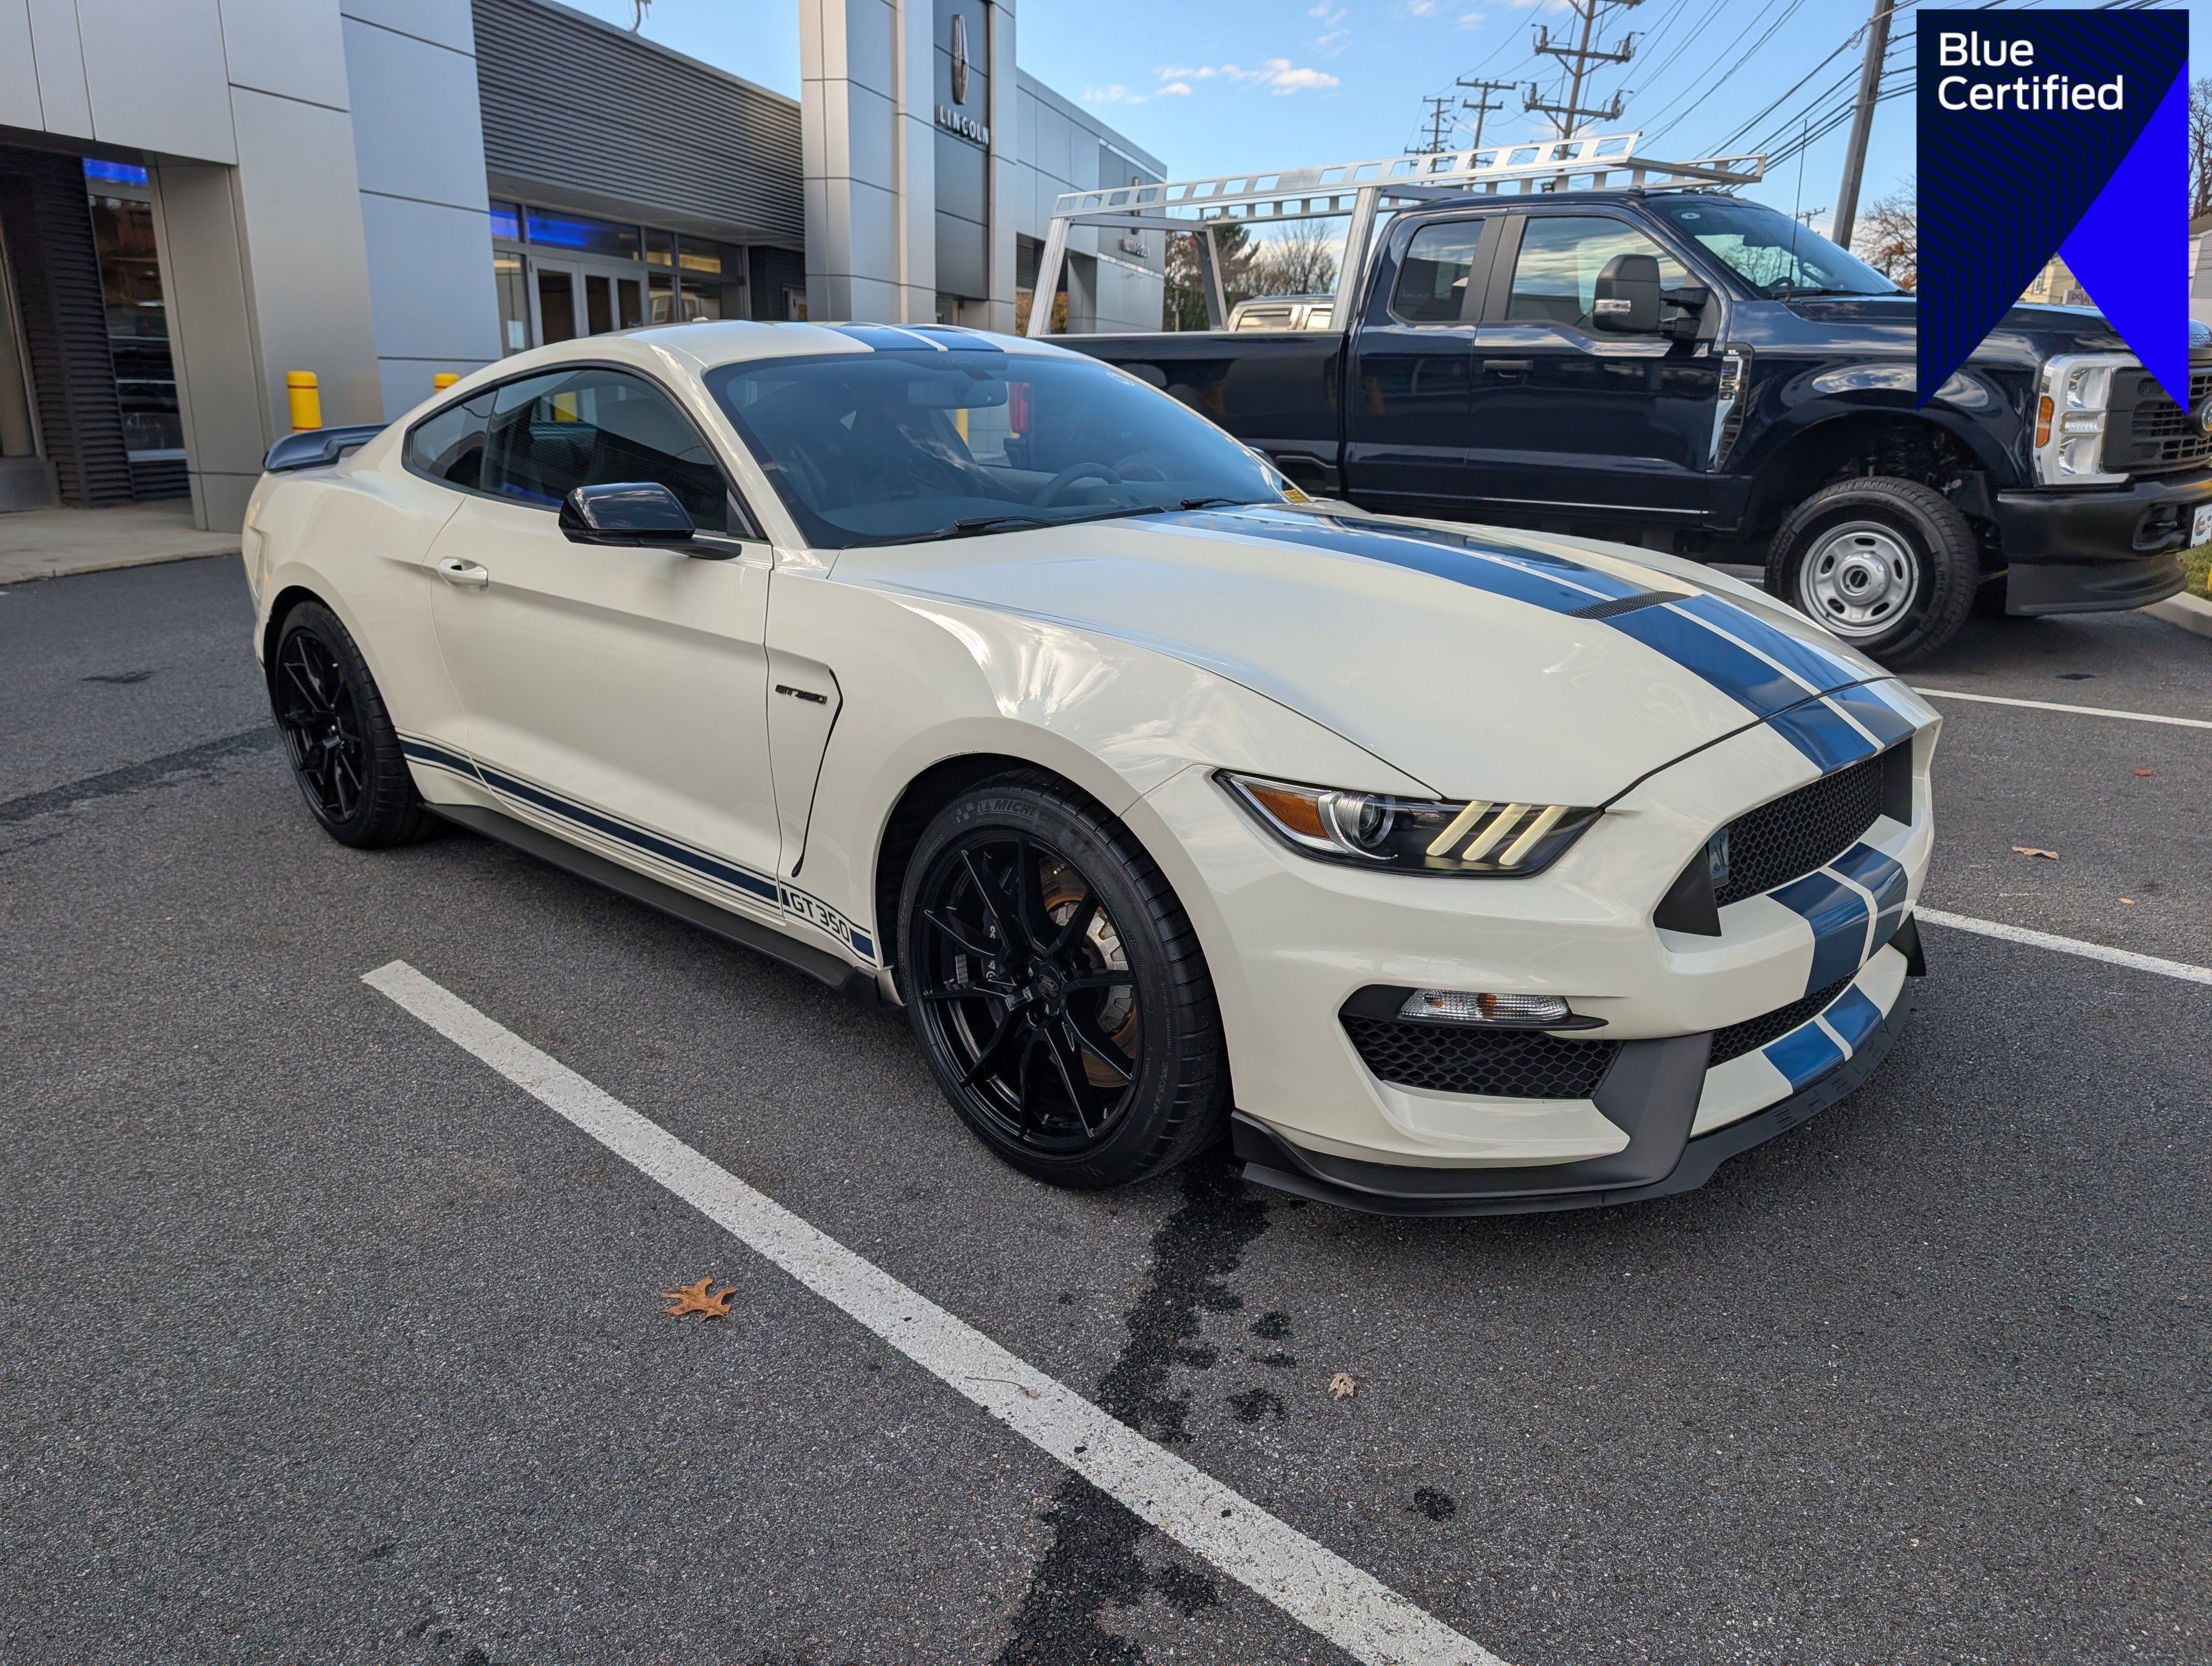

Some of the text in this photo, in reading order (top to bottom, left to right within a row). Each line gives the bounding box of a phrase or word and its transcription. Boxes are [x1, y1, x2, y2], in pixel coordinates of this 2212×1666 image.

[939, 104, 989, 145] LINCOLN
[1040, 976, 1057, 989] Ford
[1772, 1021, 1896, 1129] SHELBY
